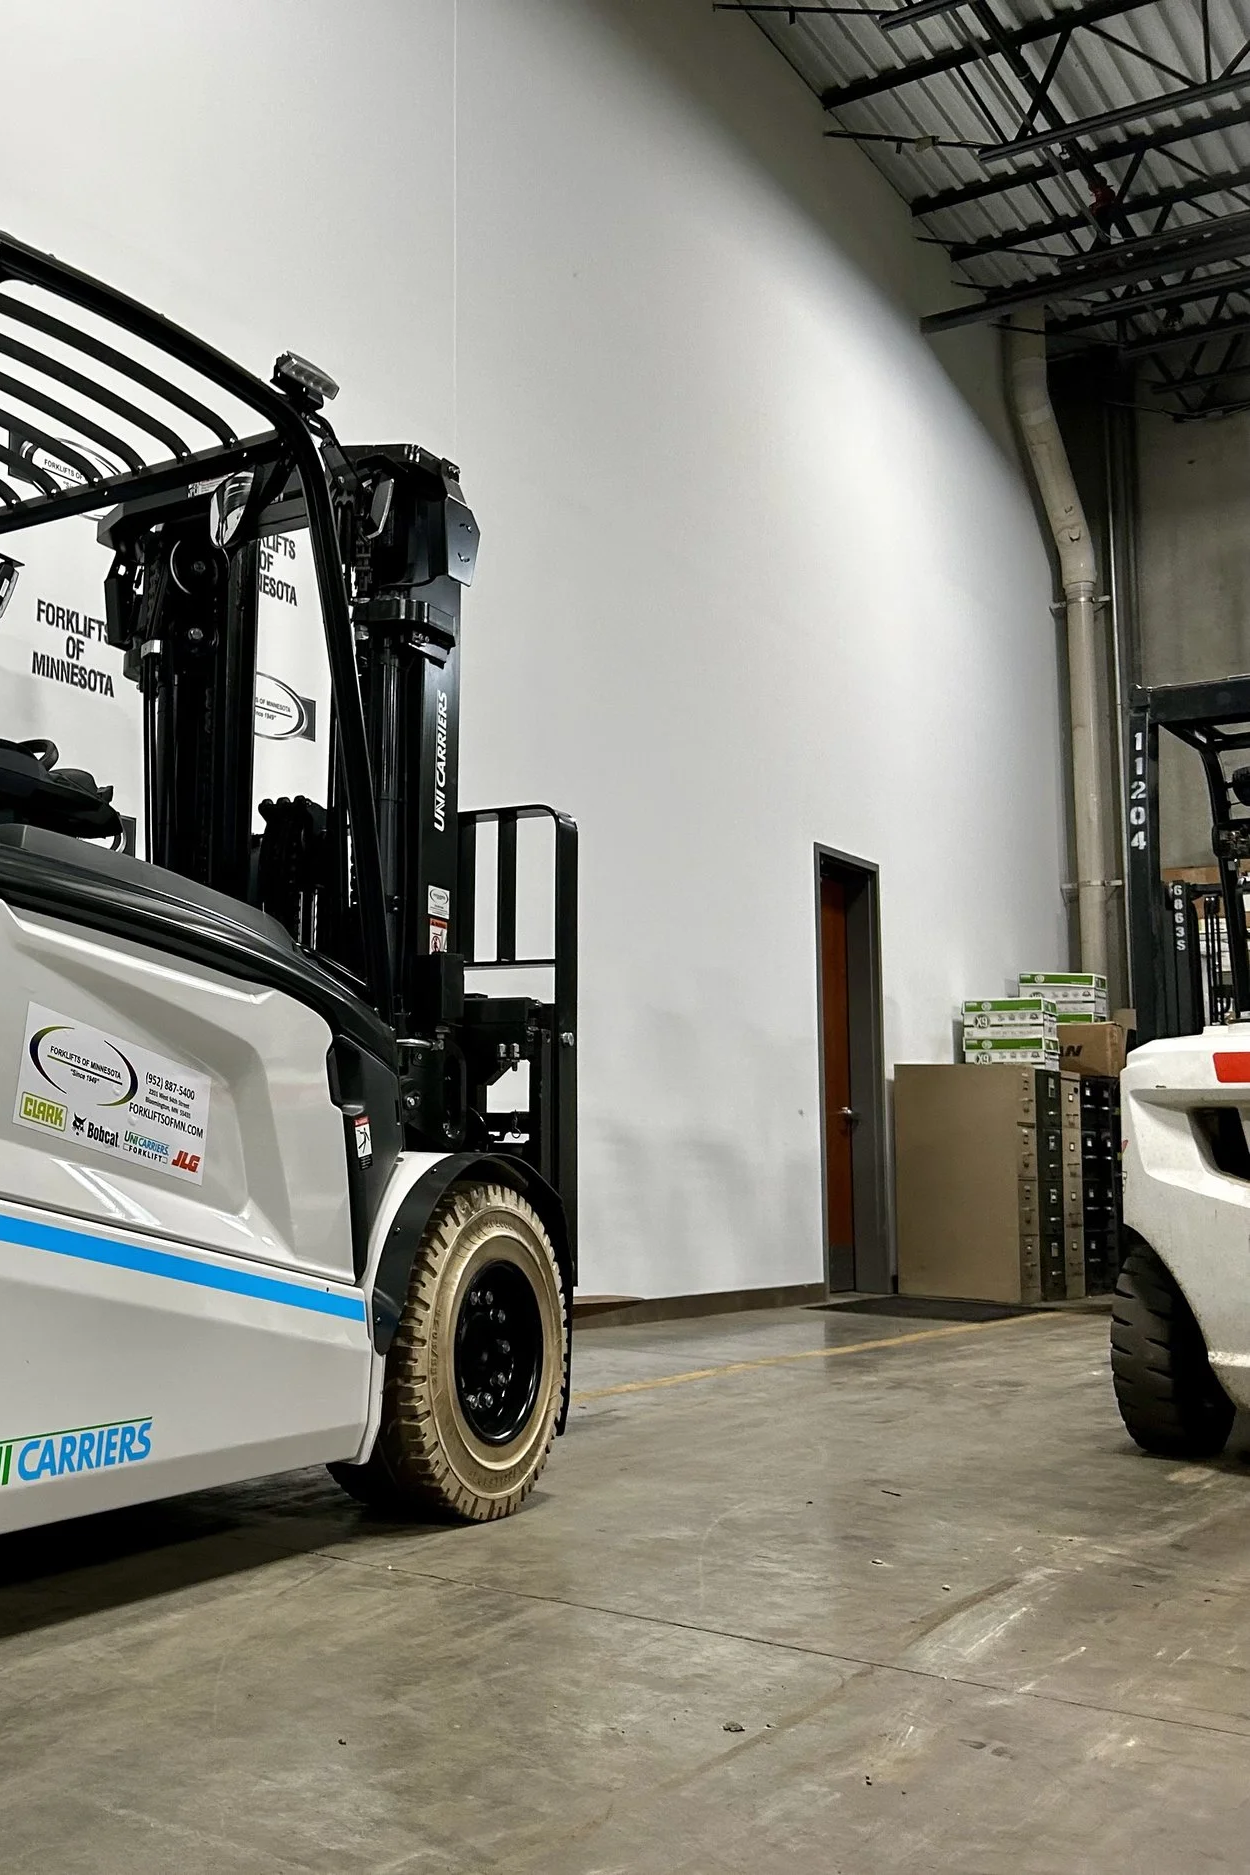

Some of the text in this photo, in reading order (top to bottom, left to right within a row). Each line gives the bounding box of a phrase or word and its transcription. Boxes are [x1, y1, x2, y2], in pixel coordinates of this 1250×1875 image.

[44, 459, 75, 477] FORKLIFTS
[260, 550, 274, 573] OF
[65, 635, 85, 661] OF
[31, 650, 115, 698] MINNESOTA
[1129, 732, 1147, 850] 11204
[50, 1045, 122, 1080] FORKLIFTS OF MINNESOTA
[145, 1071, 195, 1100] (952) 887-5400
[23, 1096, 64, 1127] CLARK
[128, 1102, 204, 1139] FORKLIFTSOFMN.COM
[86, 1121, 119, 1148] Bobcat
[128, 1145, 163, 1162] FORKLIFT
[171, 1150, 201, 1173] JLG
